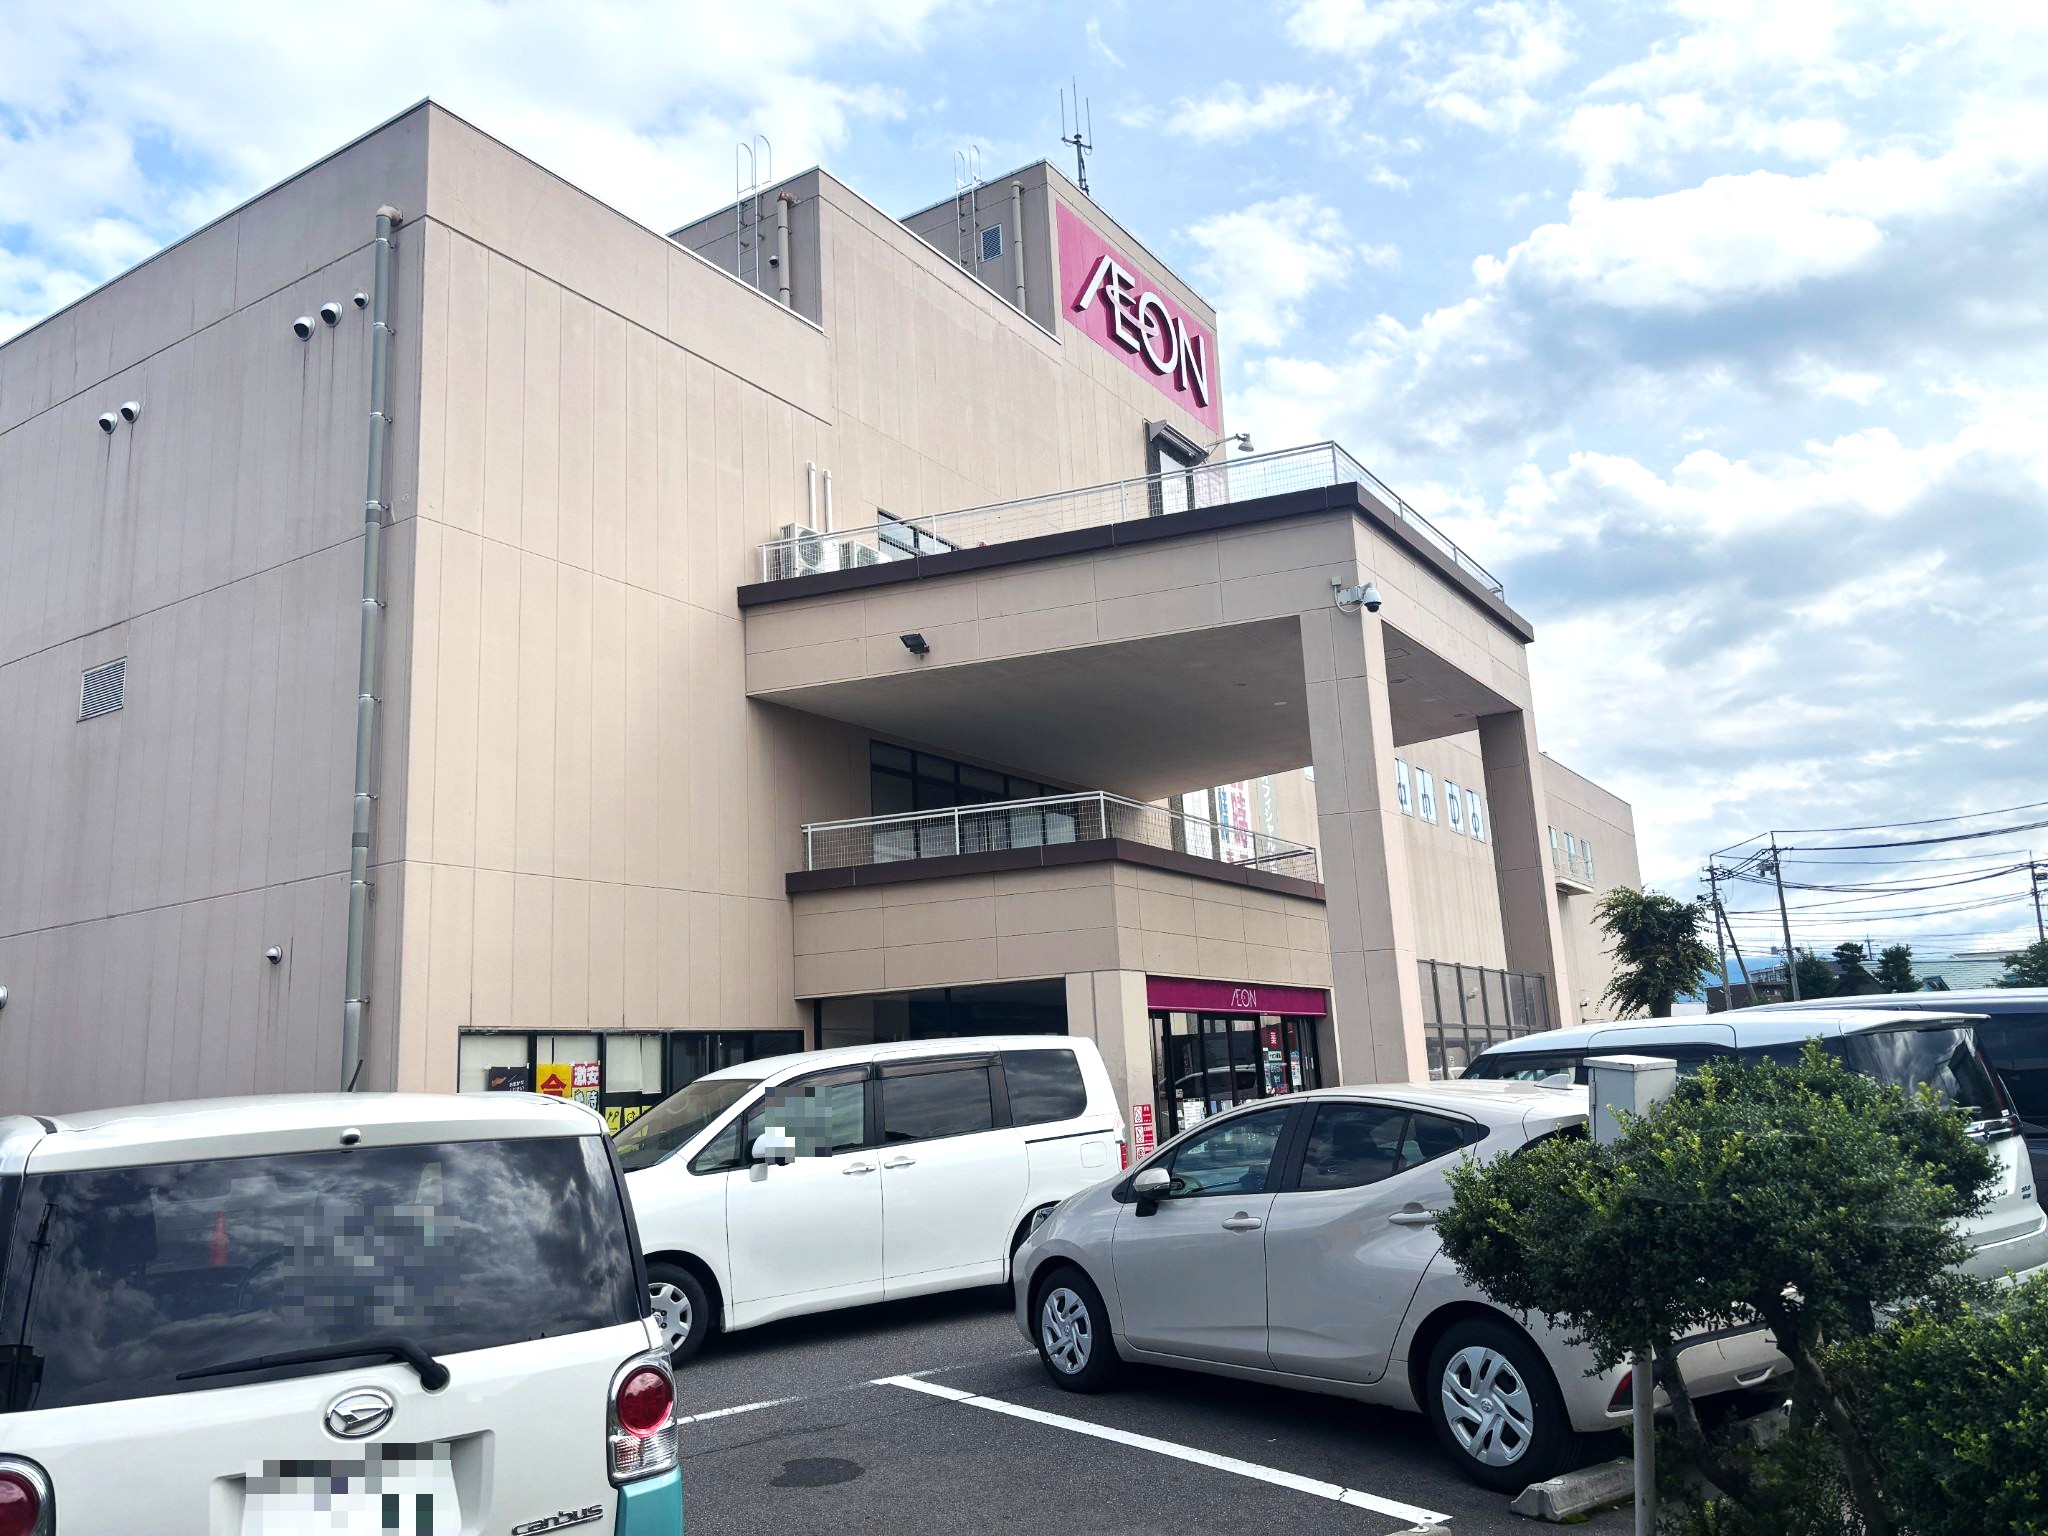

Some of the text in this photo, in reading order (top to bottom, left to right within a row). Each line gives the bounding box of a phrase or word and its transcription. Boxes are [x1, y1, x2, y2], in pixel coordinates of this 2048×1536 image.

[1072, 254, 1208, 407] AEON
[1230, 988, 1257, 1008] AEON
[574, 1066, 599, 1086] 激安
[512, 1504, 604, 1535] canbus
